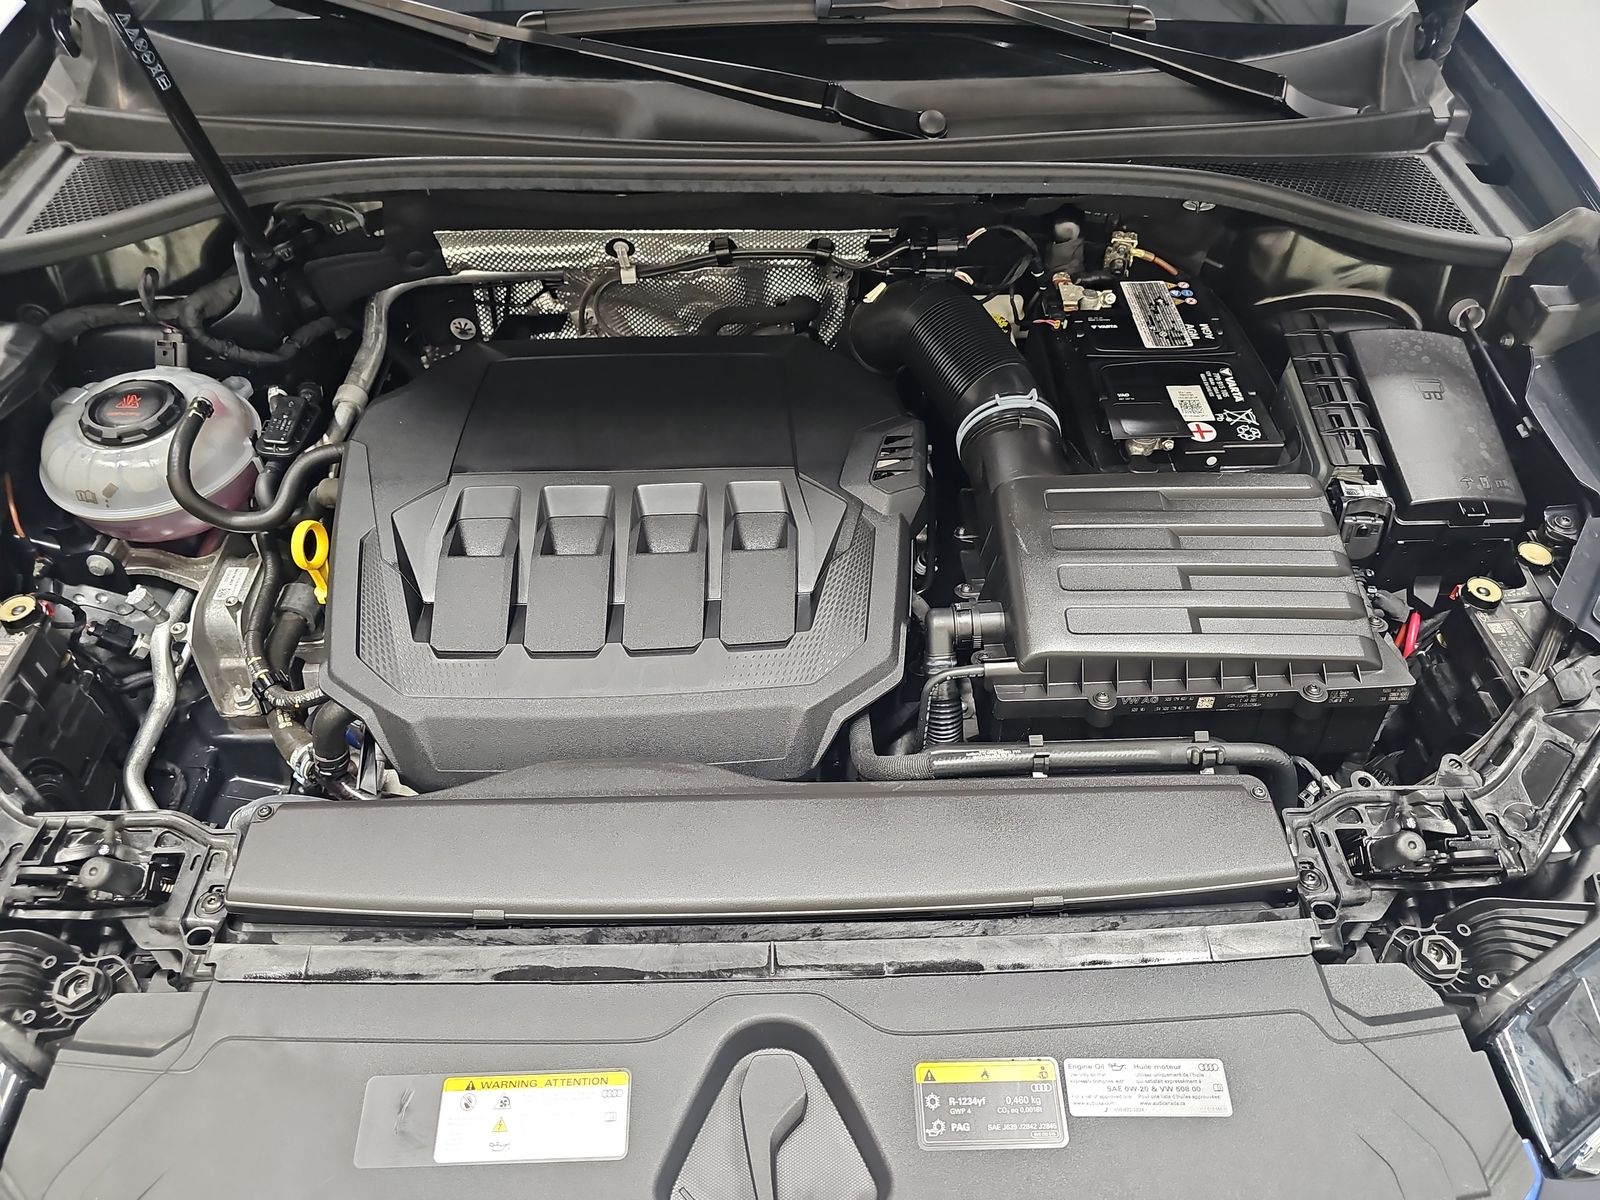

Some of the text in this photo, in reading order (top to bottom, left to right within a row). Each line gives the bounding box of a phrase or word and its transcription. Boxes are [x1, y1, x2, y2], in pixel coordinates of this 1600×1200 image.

[1185, 323, 1200, 340] AGM
[1199, 323, 1215, 340] AGM
[1225, 376, 1245, 403] VARTA
[1214, 413, 1224, 422] Pb
[1121, 697, 1140, 705] VW
[1141, 696, 1159, 704] AG
[1067, 1063, 1093, 1071] Engine
[480, 1077, 609, 1090] WARNING ATTENTION
[948, 1096, 987, 1107] R-1234yf
[1030, 1096, 1042, 1106] kg
[951, 1122, 970, 1132] PAG
